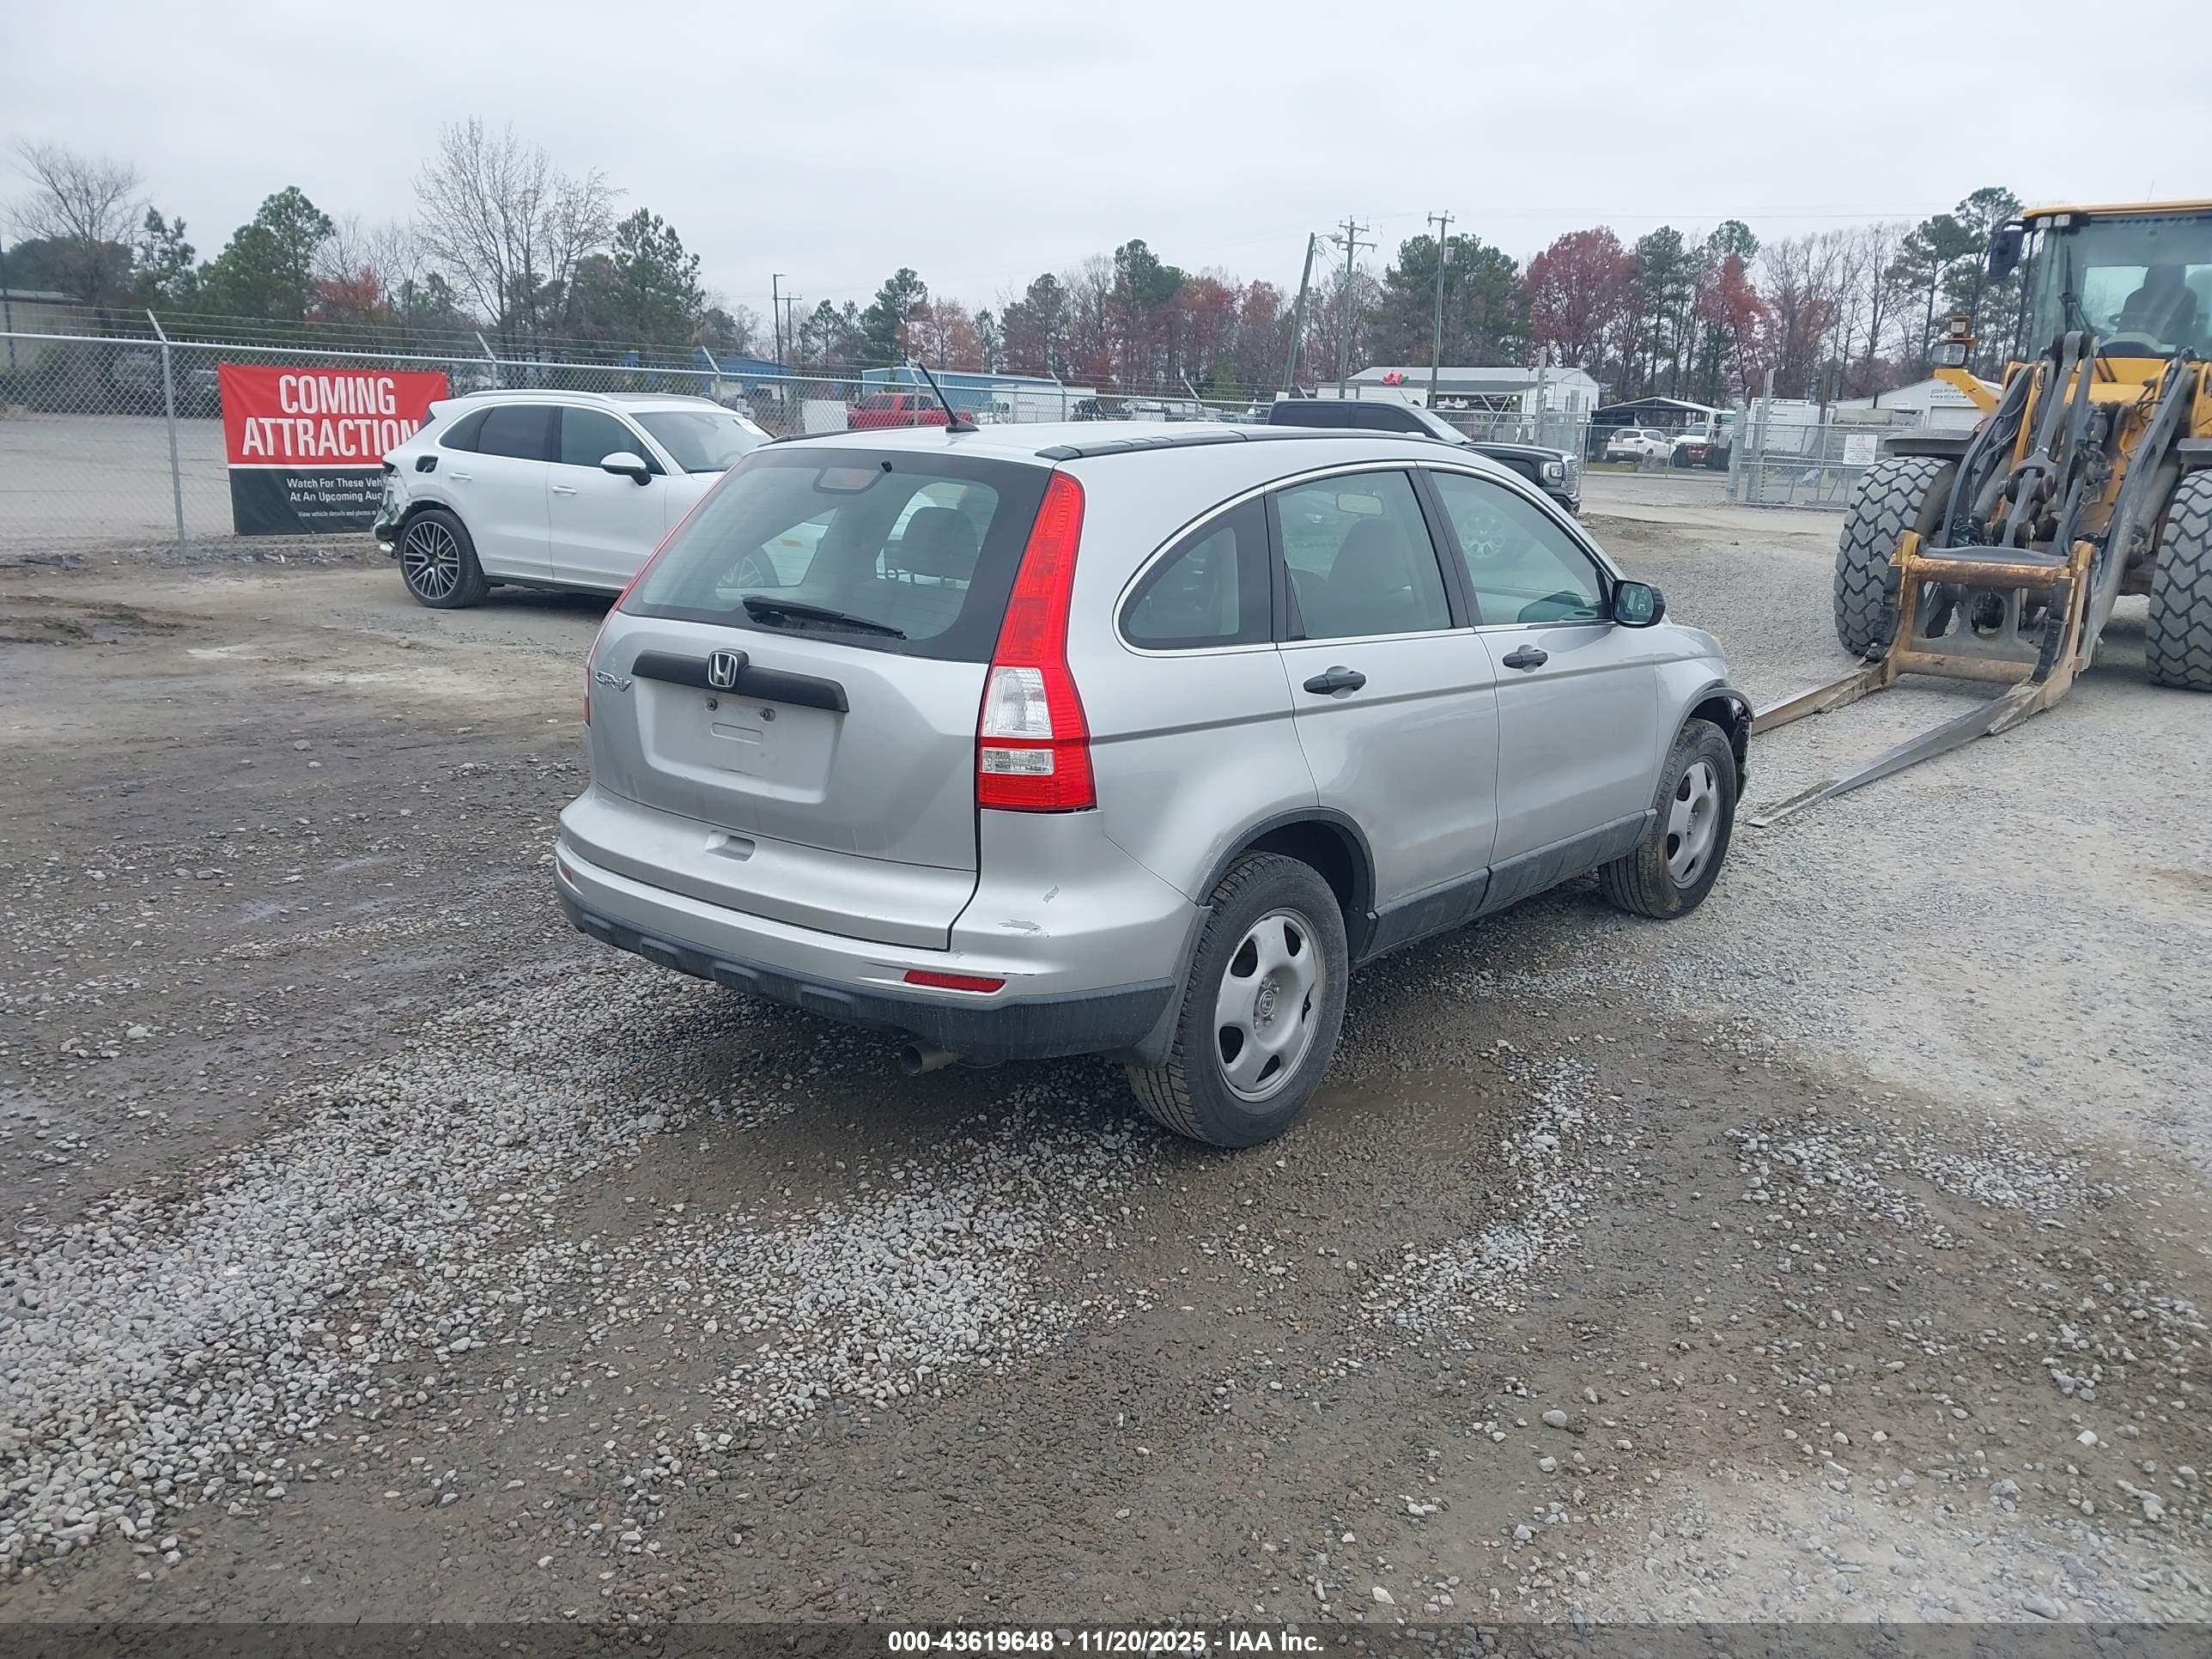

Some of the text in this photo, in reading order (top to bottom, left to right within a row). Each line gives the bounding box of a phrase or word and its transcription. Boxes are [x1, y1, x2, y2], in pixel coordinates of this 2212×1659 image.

[278, 374, 396, 416] COMING
[242, 416, 419, 457] ATTRACTION
[286, 477, 383, 489] Watch For These Veh
[289, 490, 383, 503] At An Upcoming Auc
[594, 670, 633, 693] CR-V
